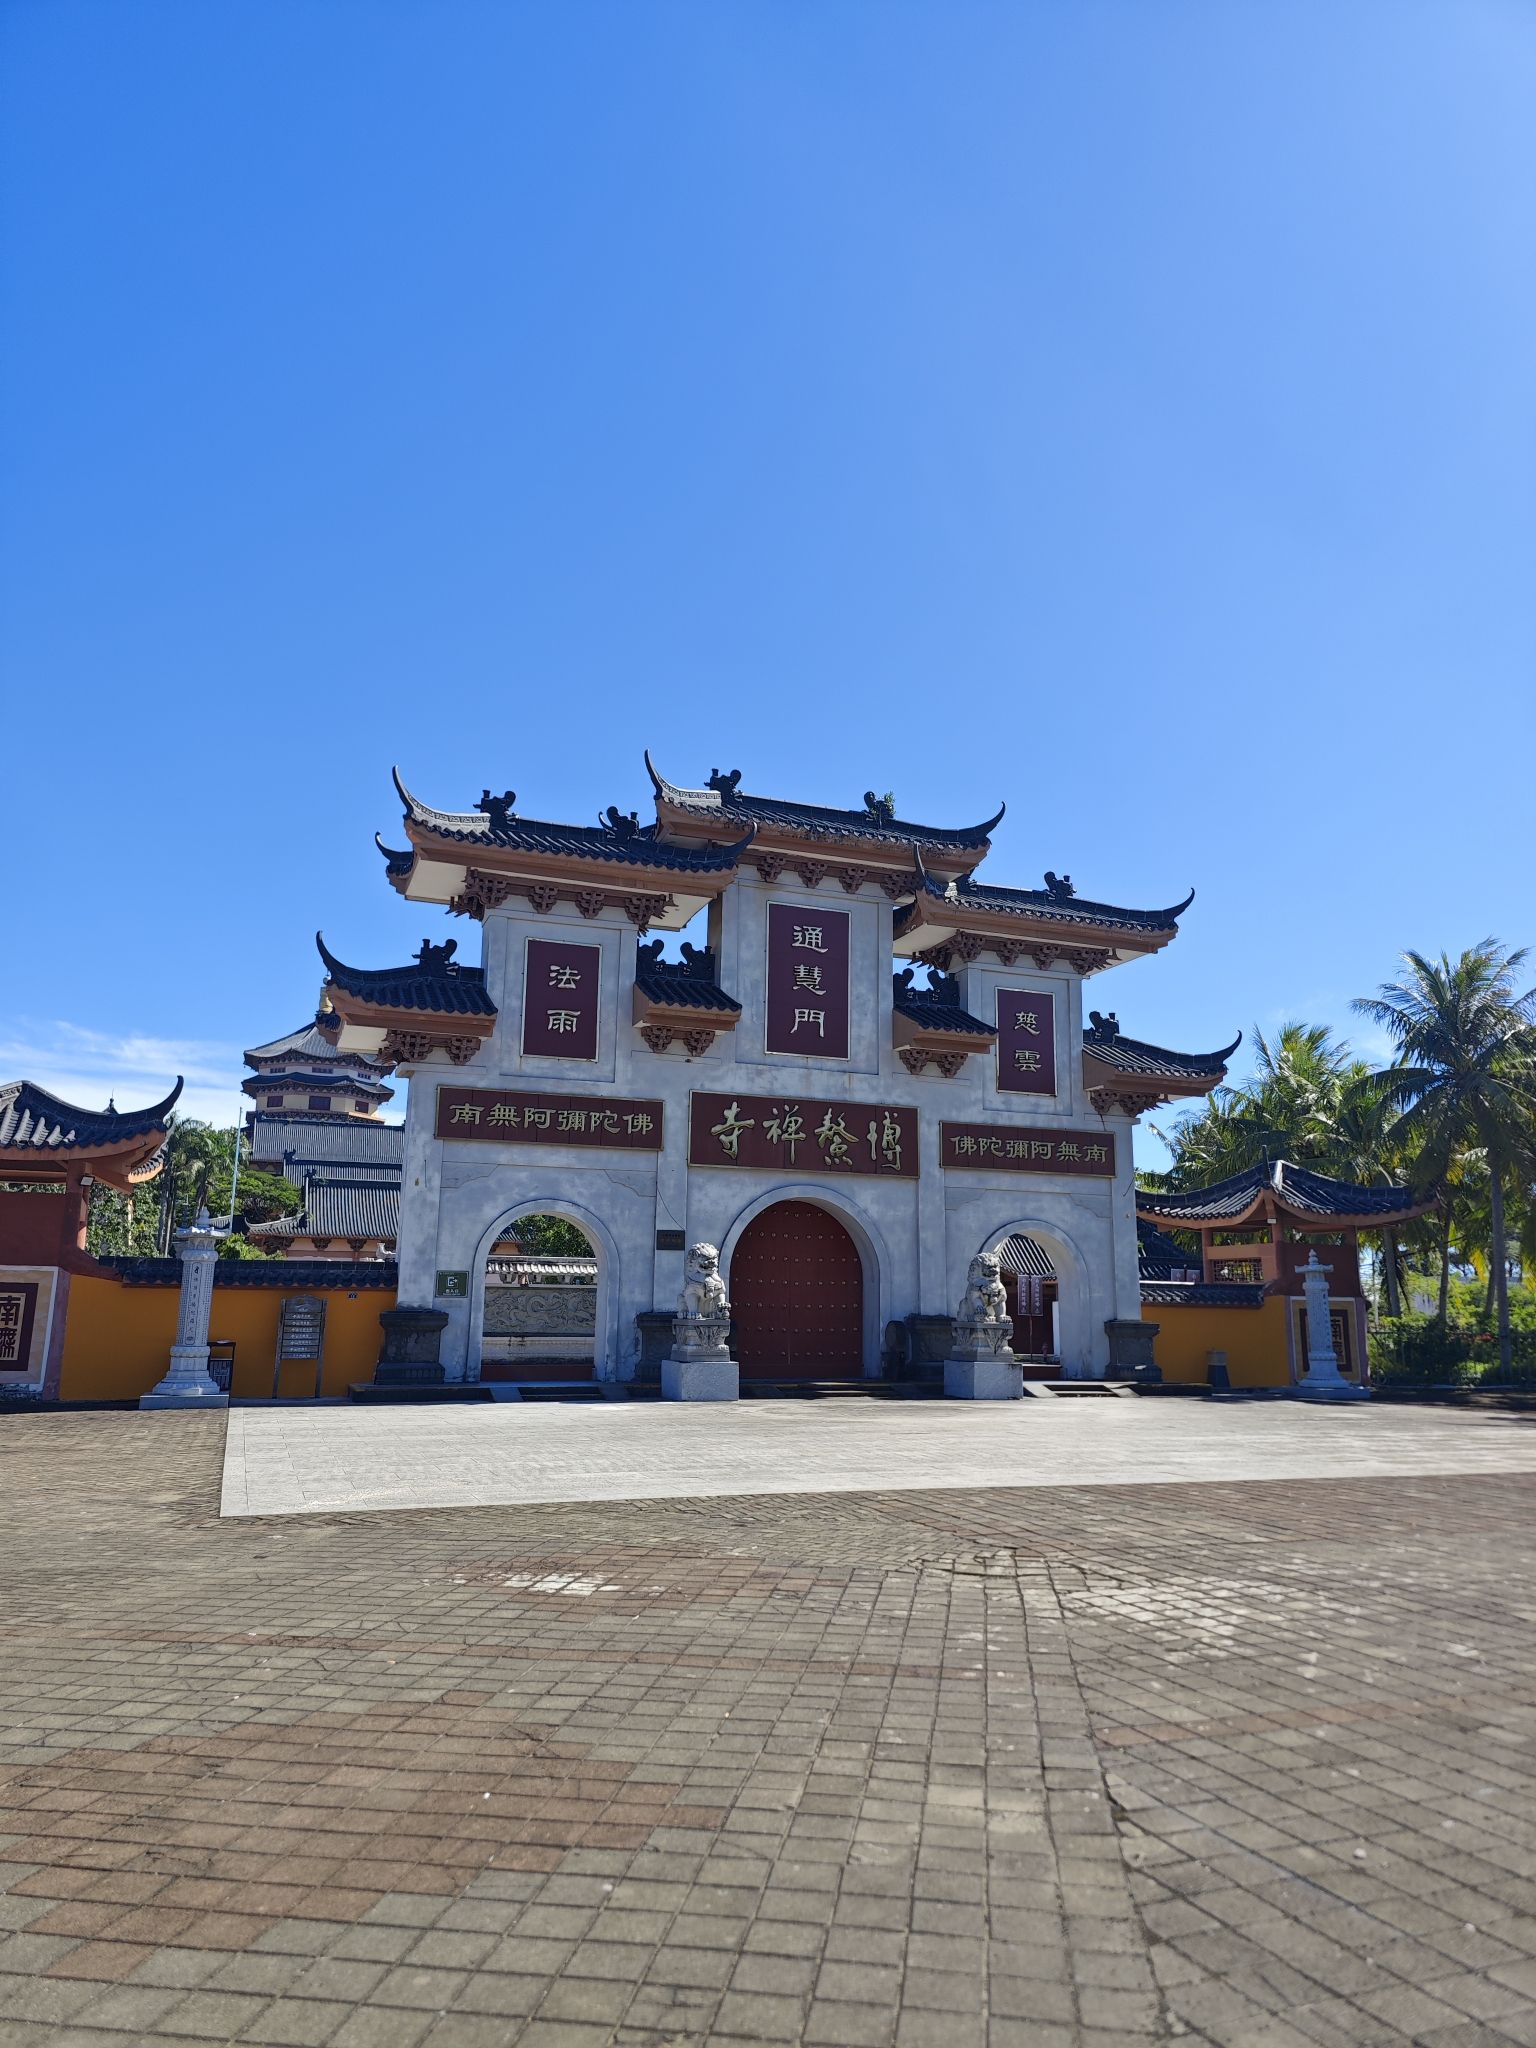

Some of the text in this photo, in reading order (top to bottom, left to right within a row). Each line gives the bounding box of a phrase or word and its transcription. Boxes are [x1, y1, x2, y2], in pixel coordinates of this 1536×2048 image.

[547, 965, 582, 1034] 法雨
[790, 925, 829, 1038] 通慧門
[1014, 1011, 1042, 1073] 慈雲
[450, 1102, 654, 1136] 南無阿彌陀佛
